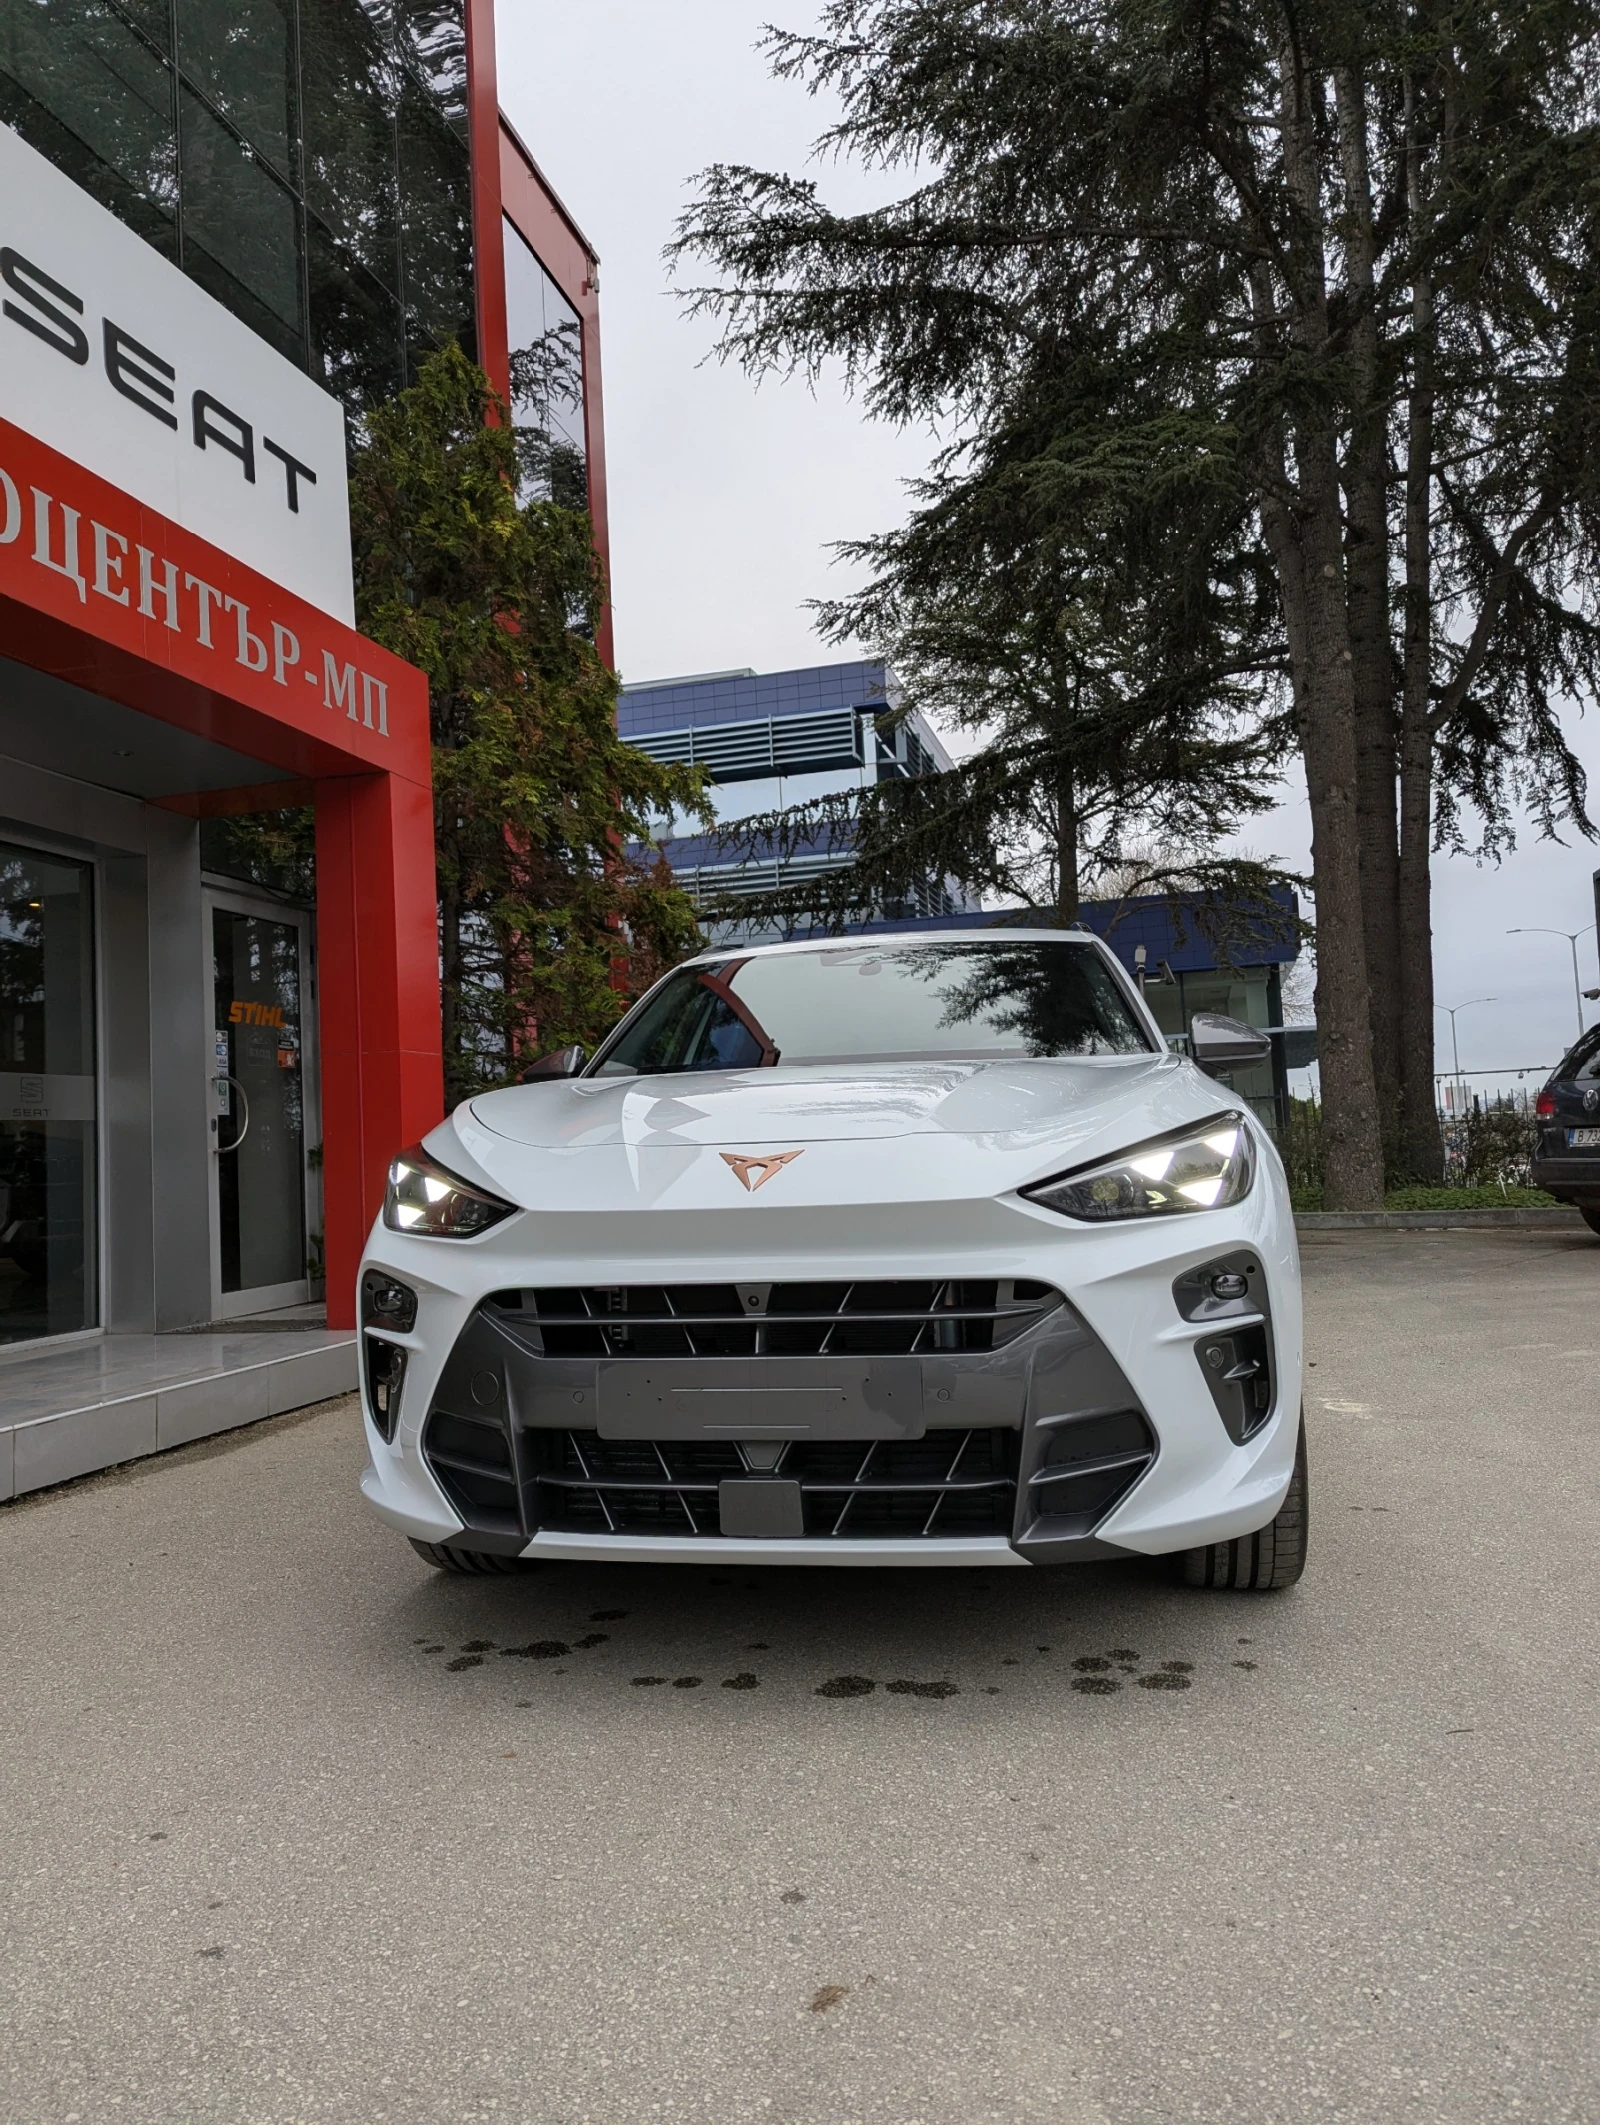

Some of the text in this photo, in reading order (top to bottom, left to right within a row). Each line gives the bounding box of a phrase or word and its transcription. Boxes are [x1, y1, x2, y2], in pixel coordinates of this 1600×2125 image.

[0, 246, 316, 513] SEAT
[228, 1001, 287, 1029] STIHL
[12, 1108, 51, 1117] SEAT
